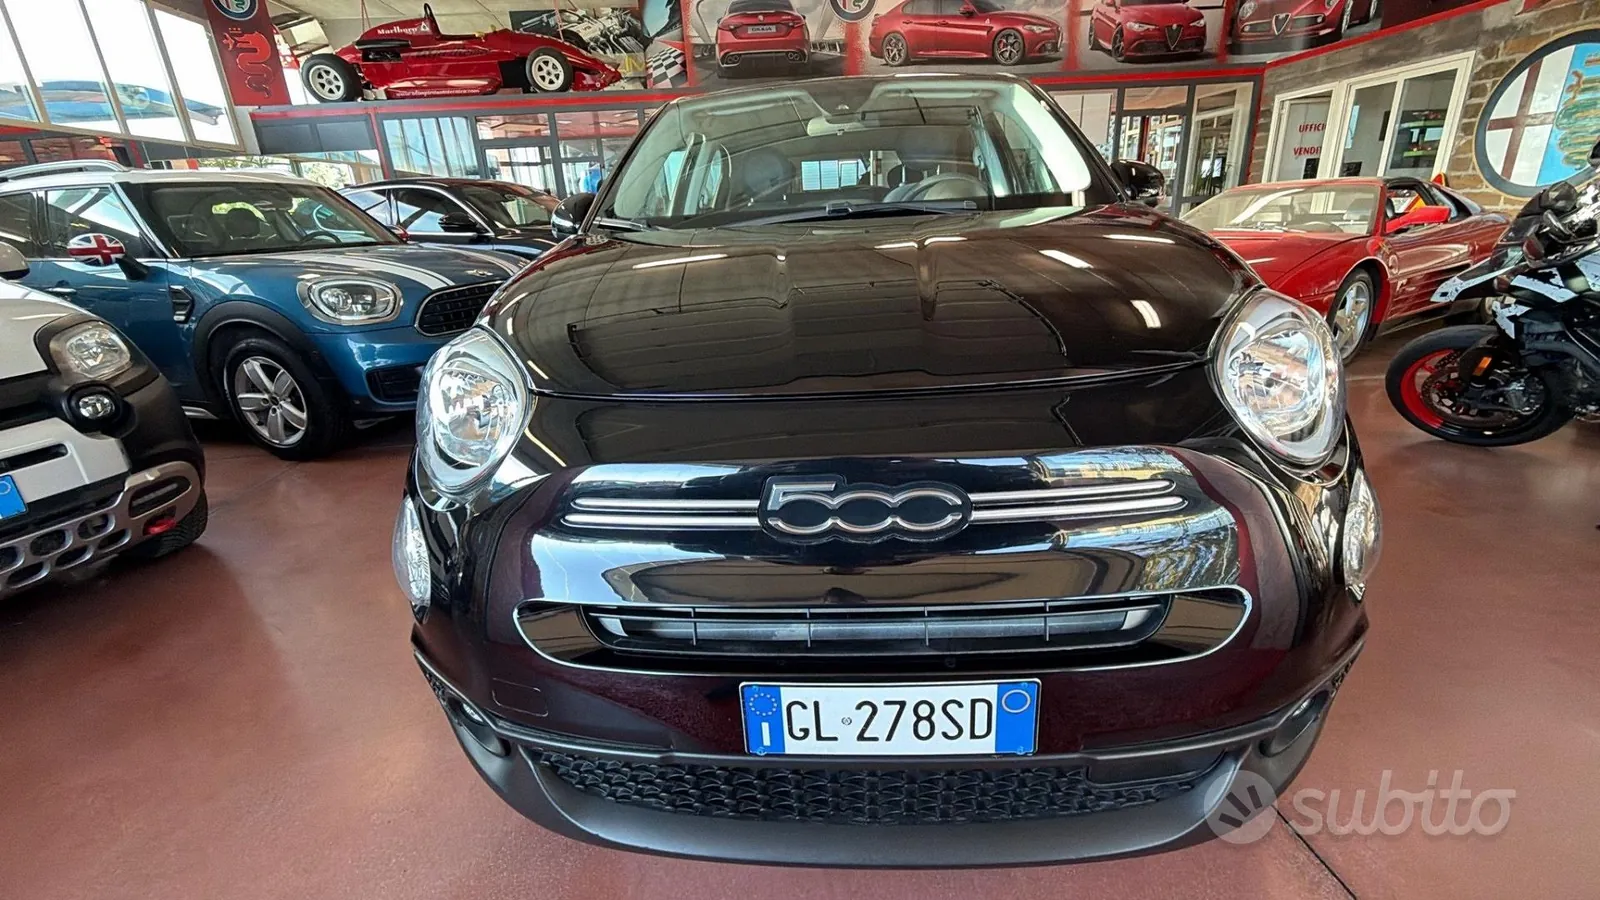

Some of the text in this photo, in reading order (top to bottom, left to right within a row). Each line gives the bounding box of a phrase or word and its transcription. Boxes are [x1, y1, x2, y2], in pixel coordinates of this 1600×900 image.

[1298, 122, 1326, 133] UFFICI
[766, 480, 963, 535] 500
[785, 698, 993, 742] GL 278SD
